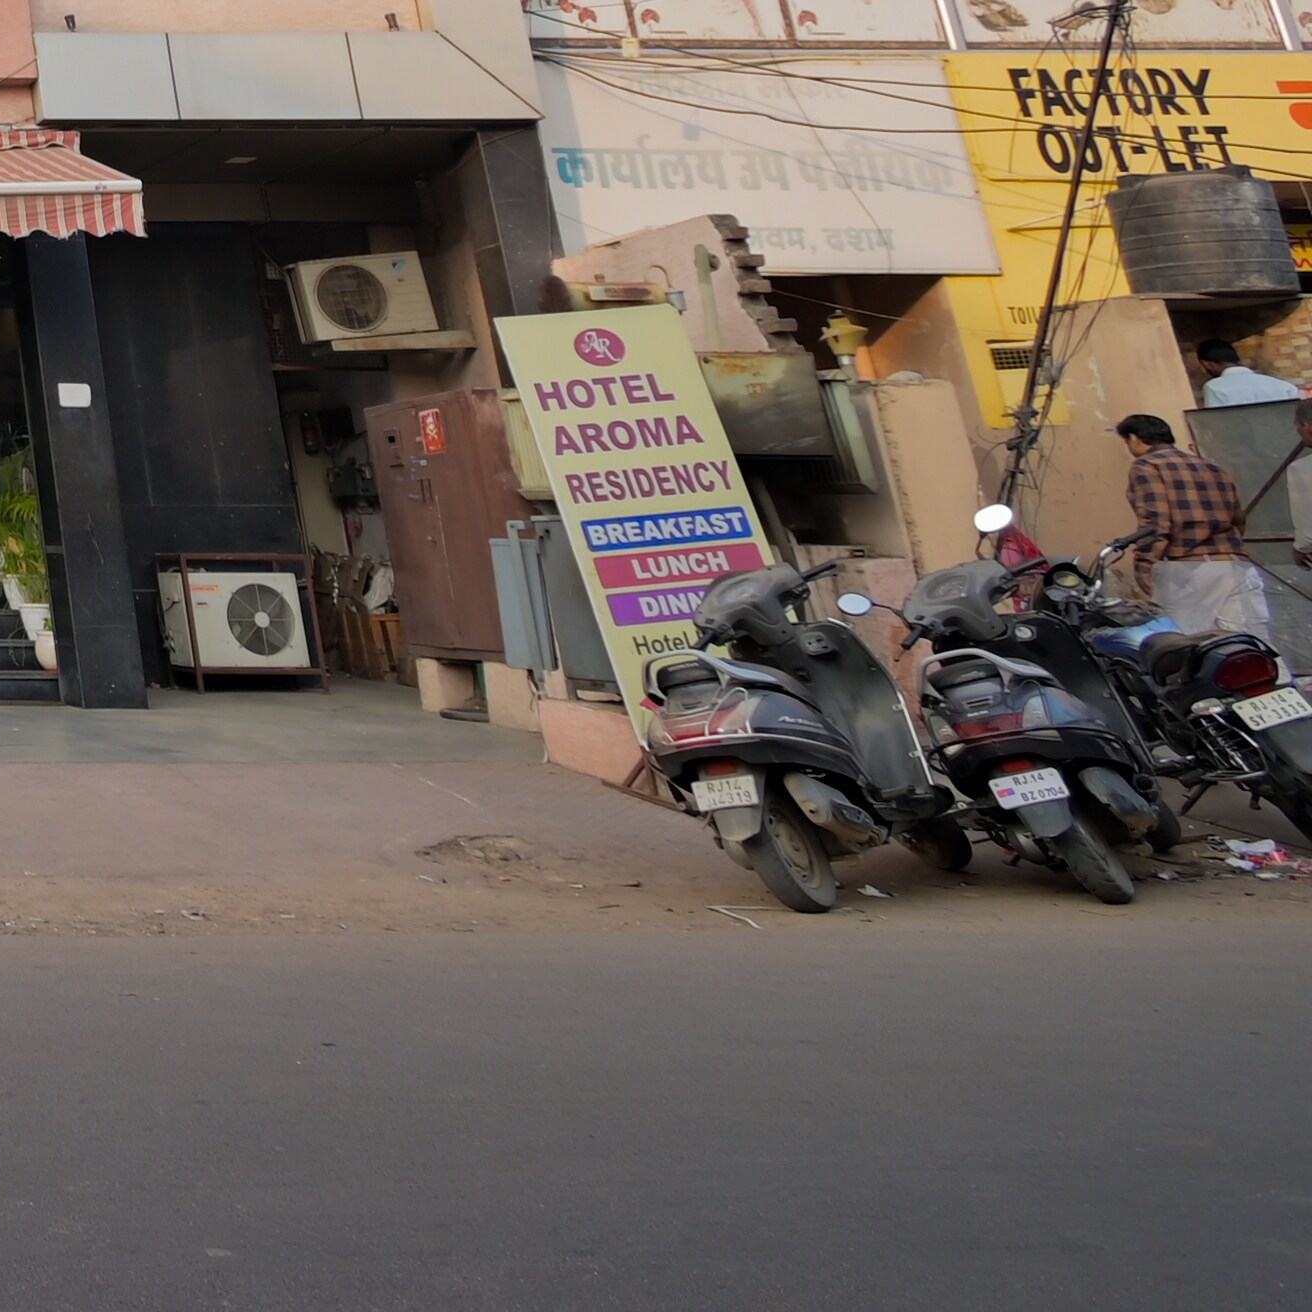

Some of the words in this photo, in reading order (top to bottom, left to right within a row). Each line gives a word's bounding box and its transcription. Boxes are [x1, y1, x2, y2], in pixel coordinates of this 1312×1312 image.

[1007, 68, 1212, 118] FACTORY
[552, 134, 726, 190] कार्यालय
[730, 148, 791, 191] उप
[1007, 305, 1046, 325] TOIL
[533, 372, 675, 412] HOTEL
[554, 414, 705, 457] AROMA
[564, 460, 734, 504] RESIDENCY
[586, 510, 746, 547] BREAKFAST
[630, 549, 730, 580] LUNCH
[638, 590, 706, 619] DINN
[632, 630, 694, 656] Hotel
